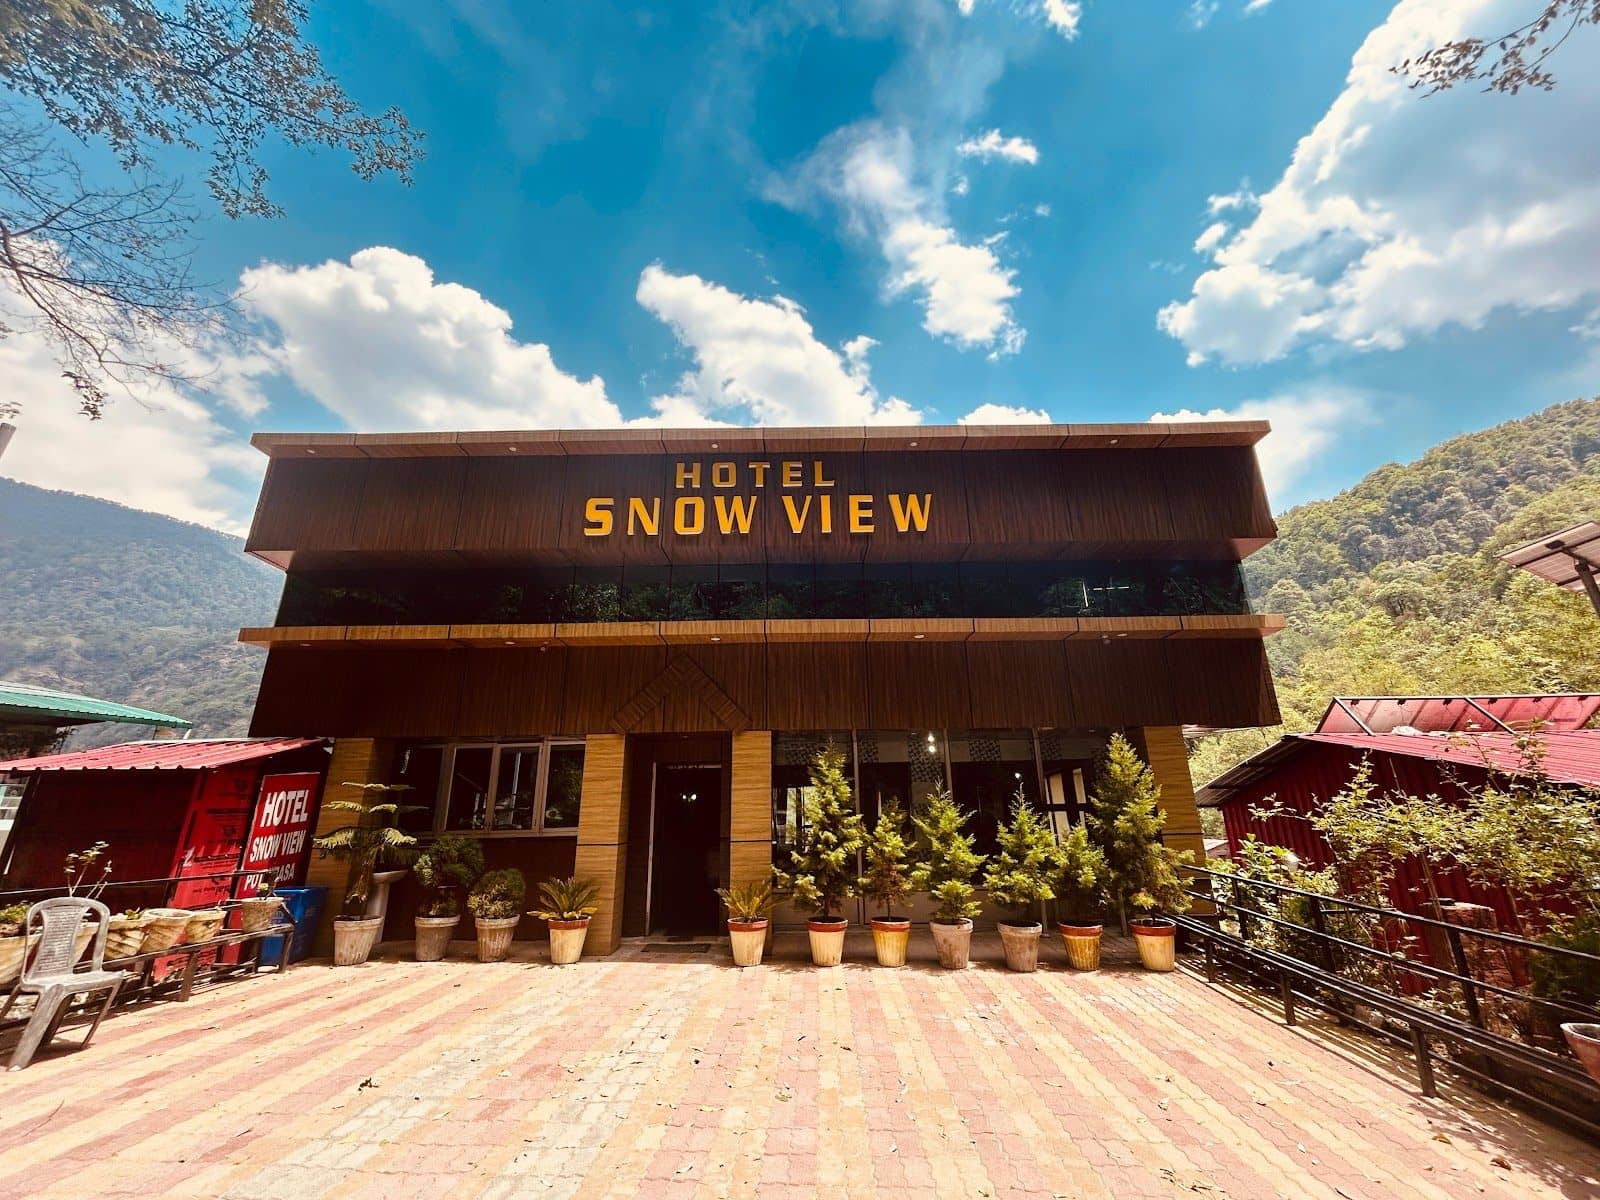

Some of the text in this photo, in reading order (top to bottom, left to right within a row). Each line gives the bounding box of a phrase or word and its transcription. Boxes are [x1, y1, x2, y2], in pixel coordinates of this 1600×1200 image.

[675, 461, 835, 488] HOTEL
[584, 494, 932, 536] SNOW VIEW
[260, 789, 309, 828] HOTEL
[249, 830, 307, 863] SNOW VIEW
